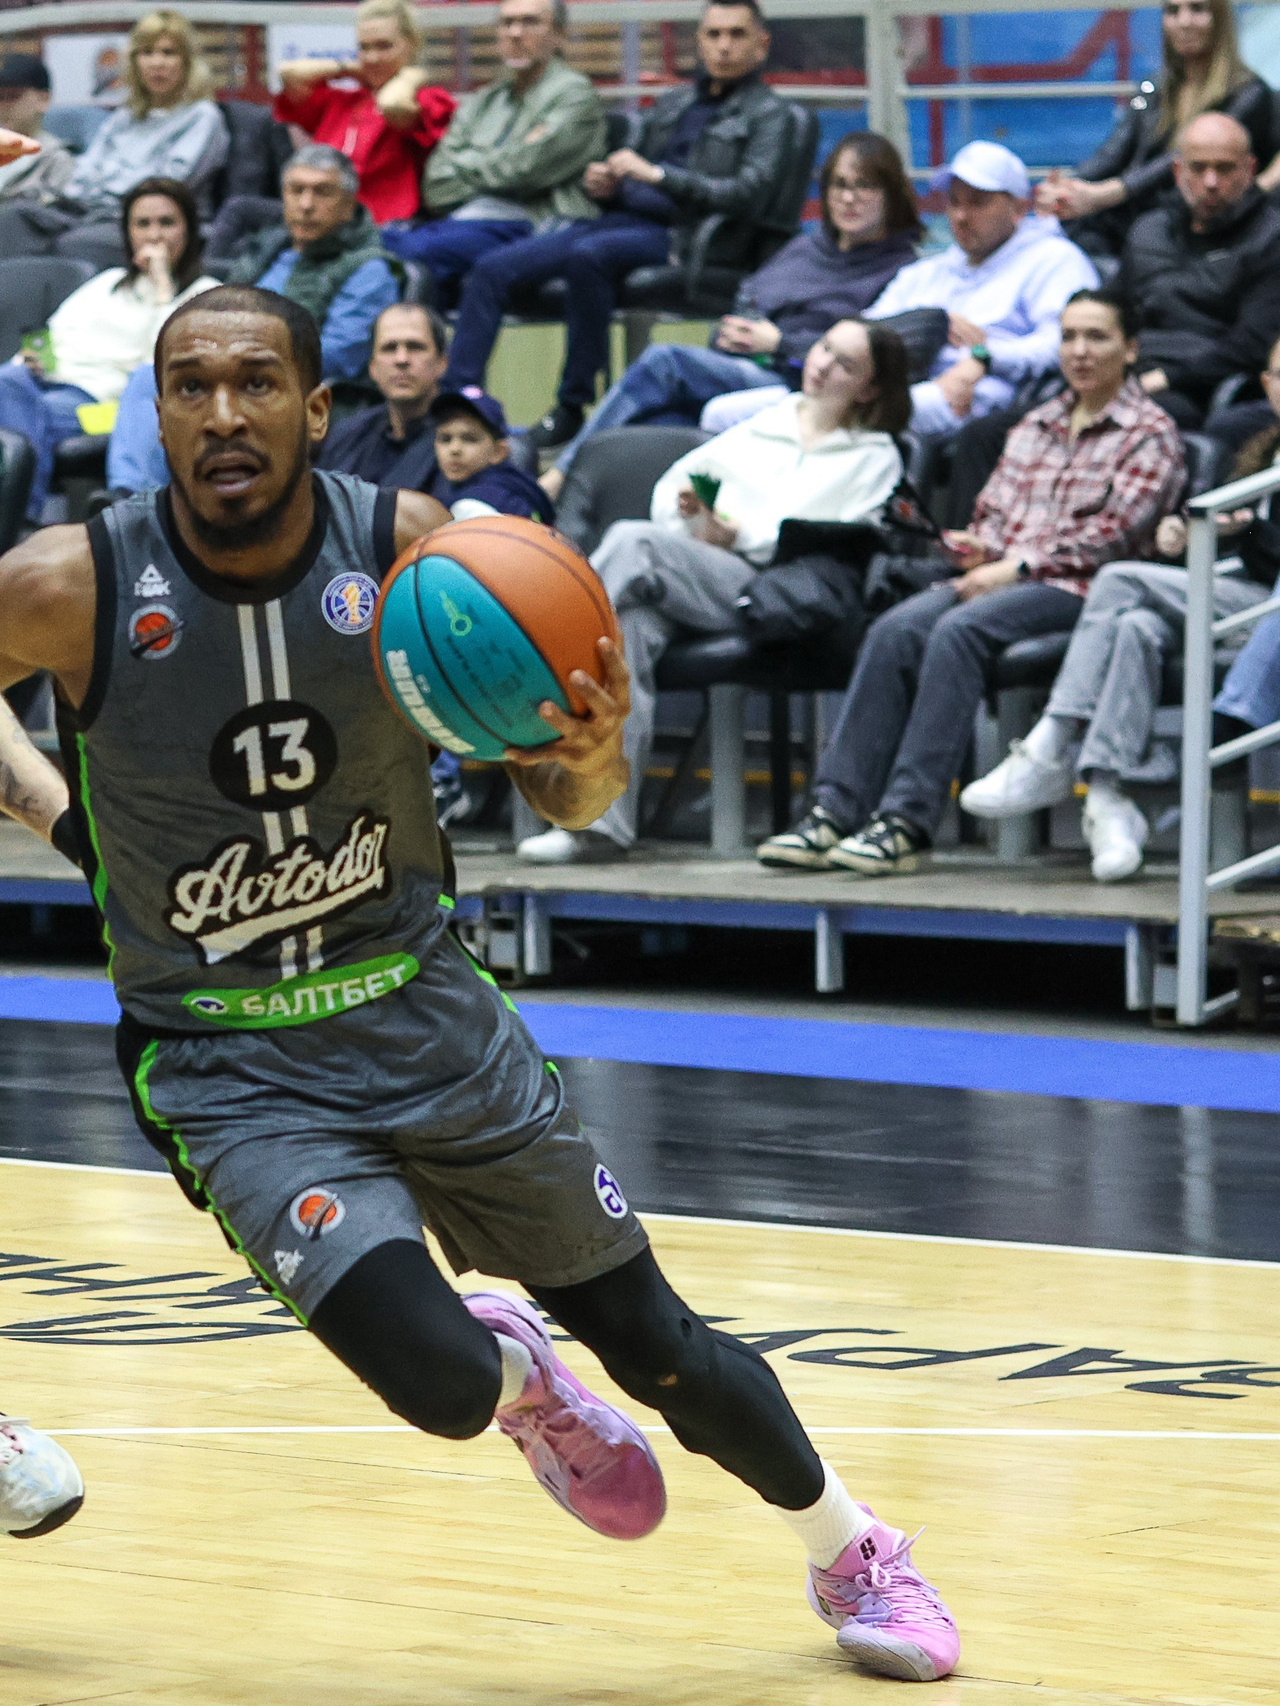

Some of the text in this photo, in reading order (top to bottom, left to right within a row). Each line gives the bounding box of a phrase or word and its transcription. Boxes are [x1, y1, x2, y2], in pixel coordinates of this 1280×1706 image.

[232, 717, 317, 797] 13
[170, 815, 388, 934] Avtodor
[242, 963, 407, 1017] БАЛТБЕТ
